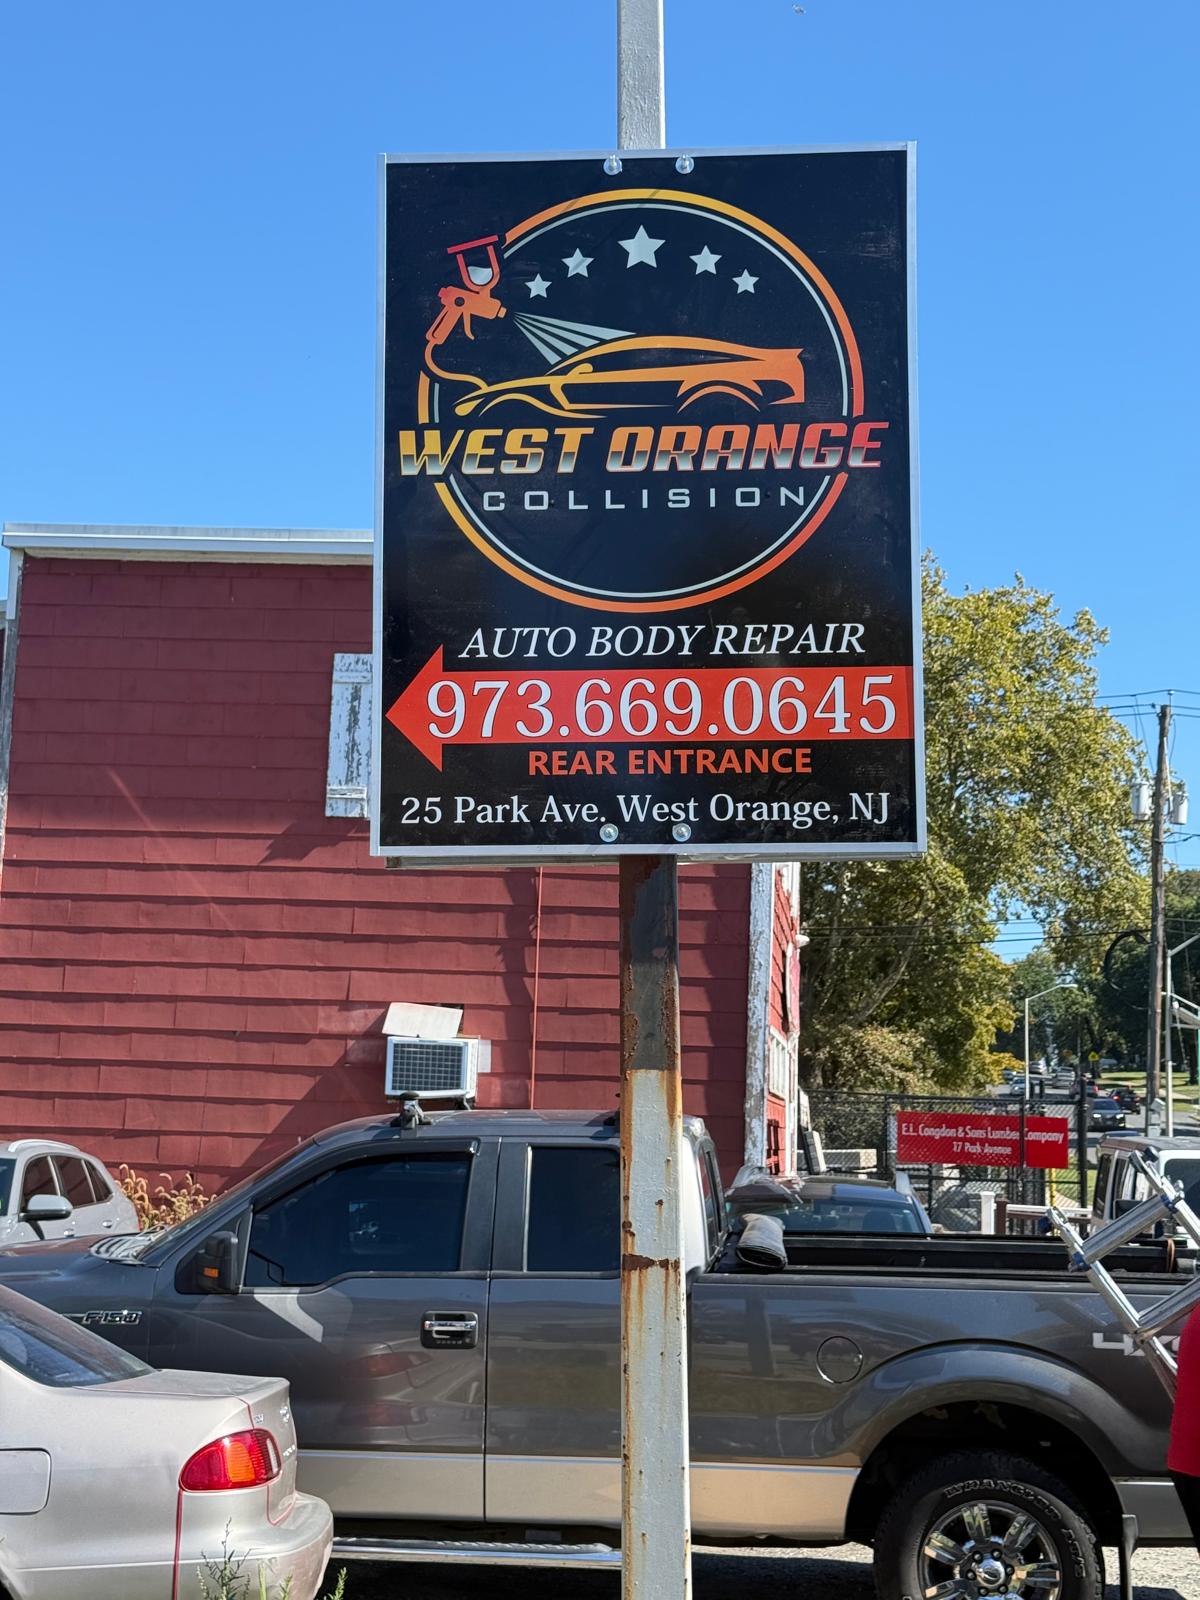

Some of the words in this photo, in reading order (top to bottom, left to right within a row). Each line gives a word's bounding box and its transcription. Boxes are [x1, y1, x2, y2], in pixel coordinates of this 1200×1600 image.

[399, 427, 595, 477] WEST
[606, 420, 890, 474] ORANGE
[482, 485, 807, 512] COLLISION
[458, 626, 577, 659] AUTO
[585, 624, 706, 657] BODY
[709, 622, 866, 655] REPAIR
[426, 674, 897, 739] 973.669.0645
[528, 750, 618, 776] REAR
[628, 748, 813, 775] ENTRANCE
[400, 796, 443, 824] 25
[453, 795, 531, 824] Park
[539, 794, 607, 823] Ave.
[616, 794, 700, 823] West
[708, 793, 839, 830] Orange,
[849, 792, 891, 825] NJ
[918, 1124, 957, 1140] Congdon
[957, 1127, 965, 1139] &
[953, 1142, 962, 1153] 17
